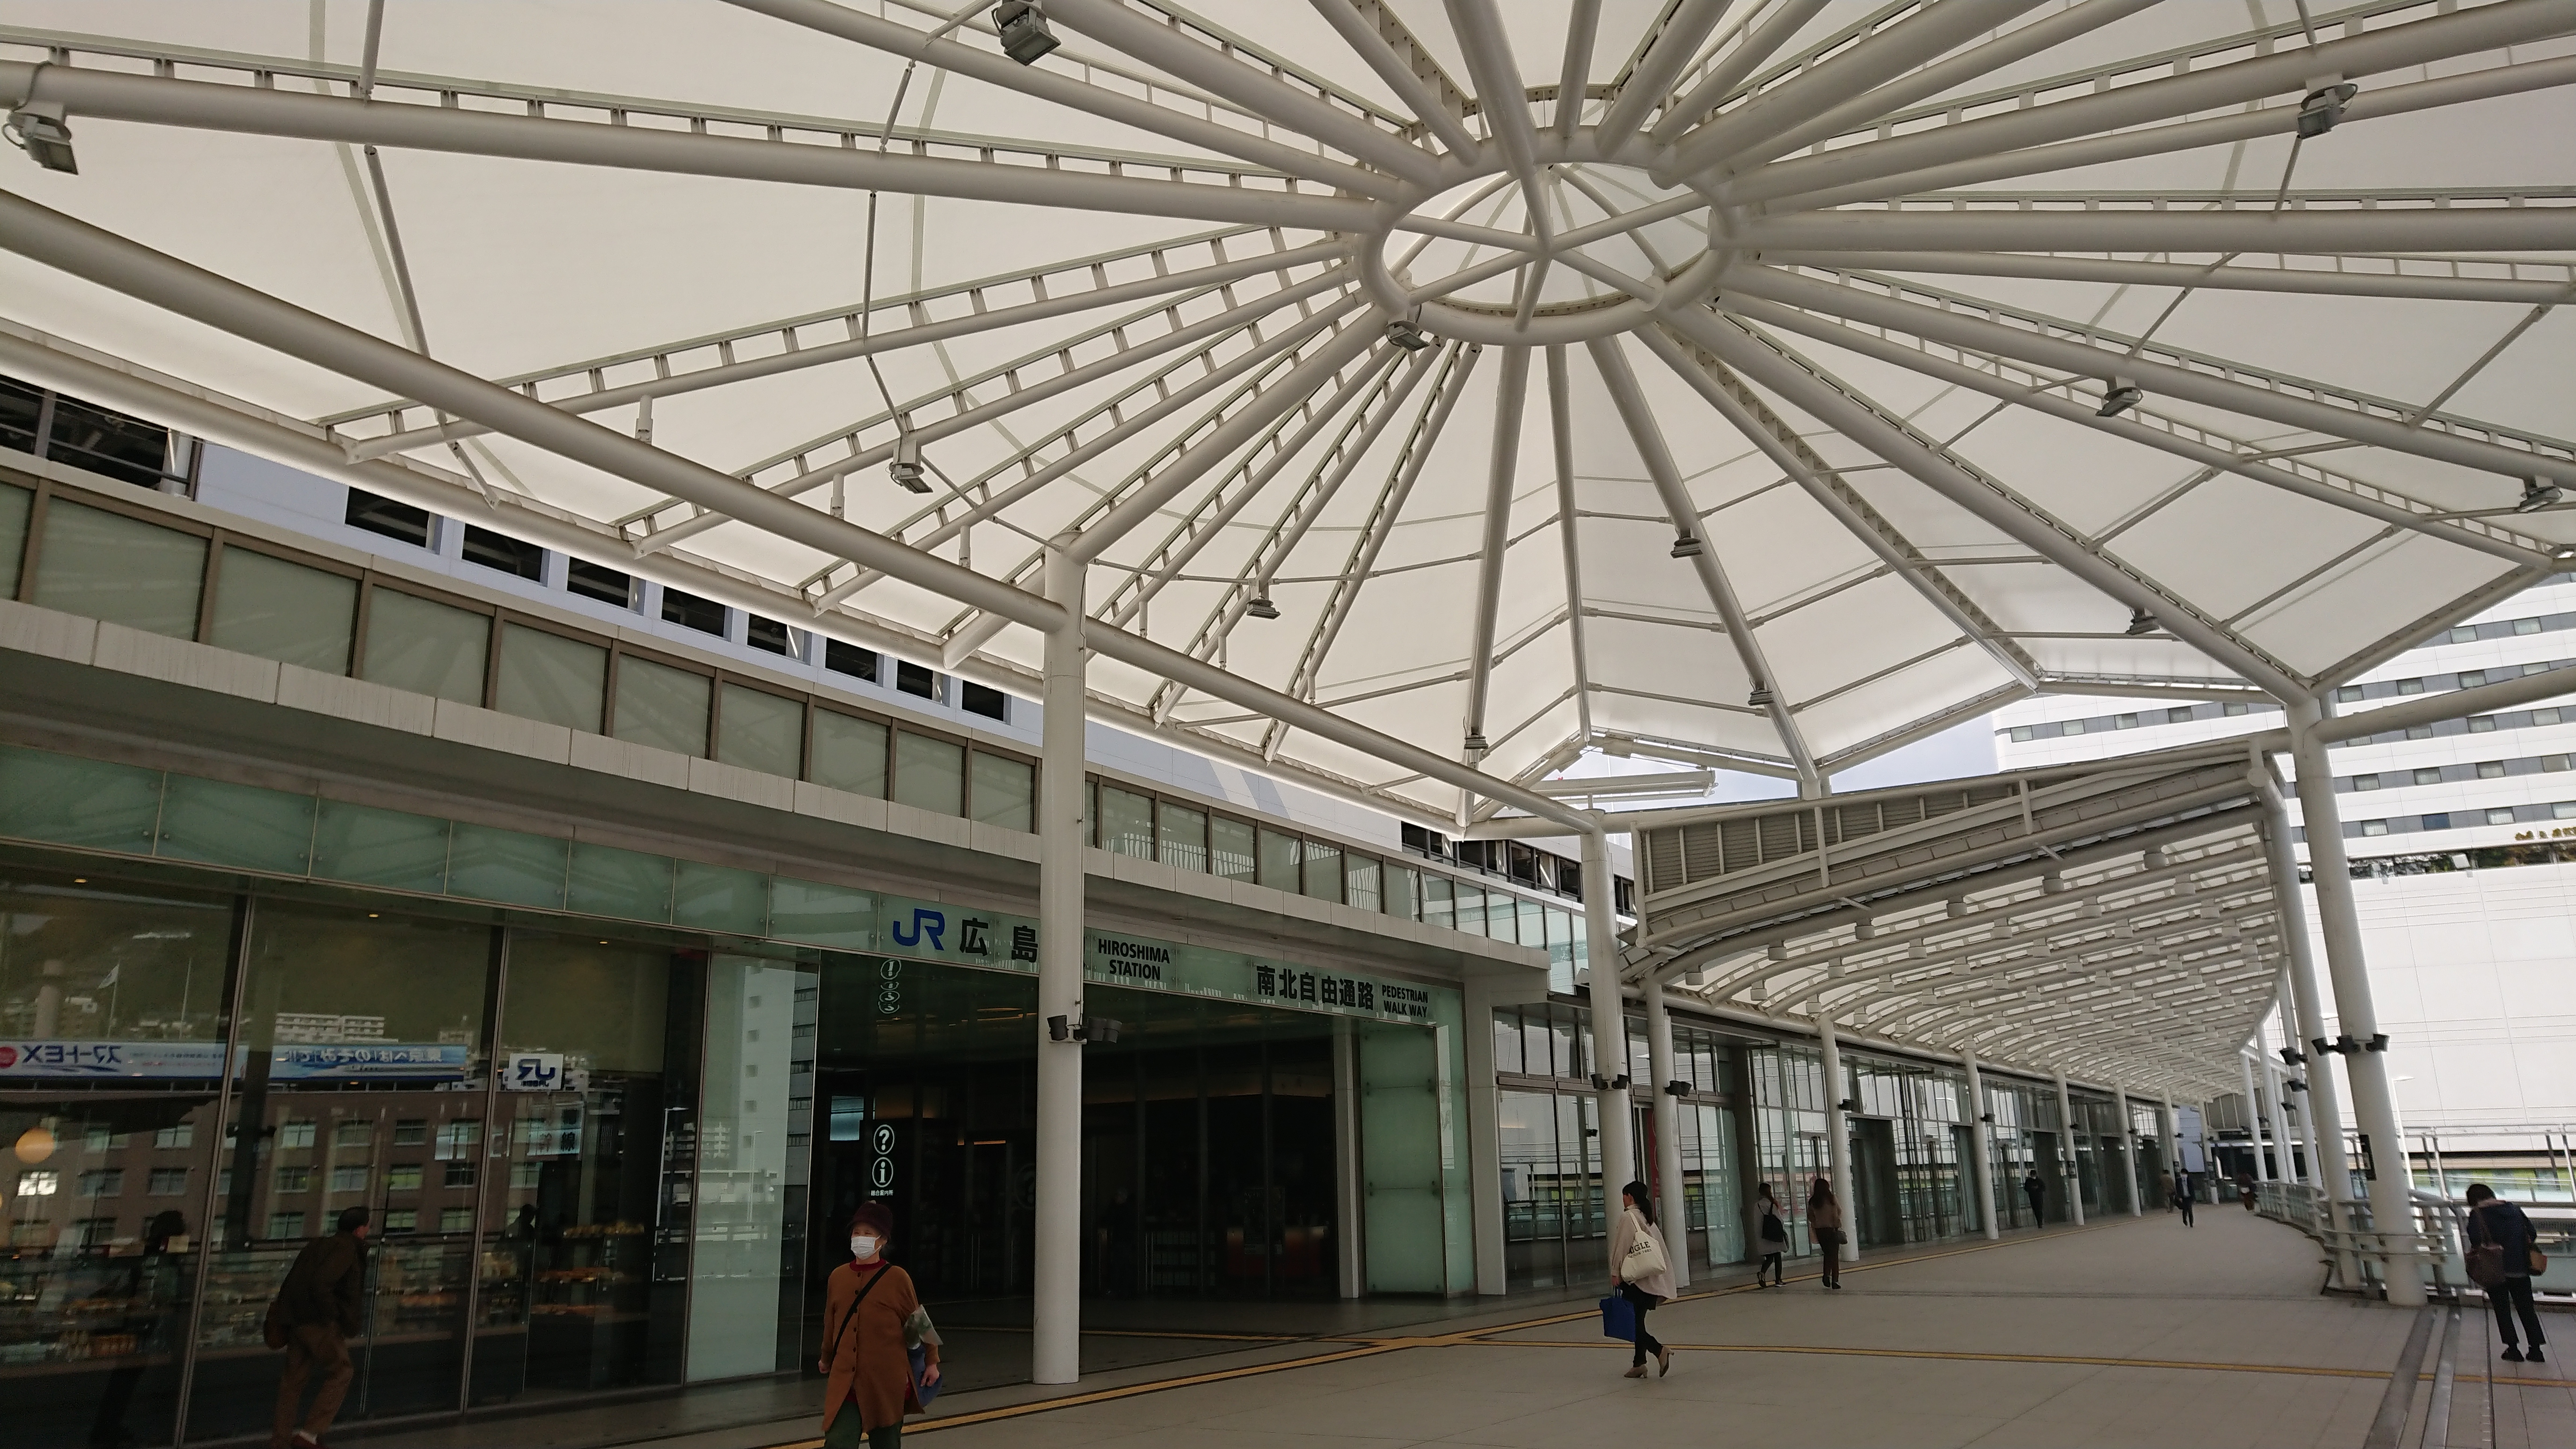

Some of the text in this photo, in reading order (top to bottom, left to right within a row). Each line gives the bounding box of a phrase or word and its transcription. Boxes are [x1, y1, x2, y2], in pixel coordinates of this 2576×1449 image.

[892, 907, 945, 951] JR
[1098, 938, 1170, 964] HIROSHIMA
[1109, 959, 1161, 981] STATION
[1256, 965, 1374, 1011] 南北自由通路
[1382, 984, 1428, 1003] PEDESTRIAN
[1383, 1000, 1428, 1018] WALK WAY
[1628, 1241, 1651, 1255] AIGLE
